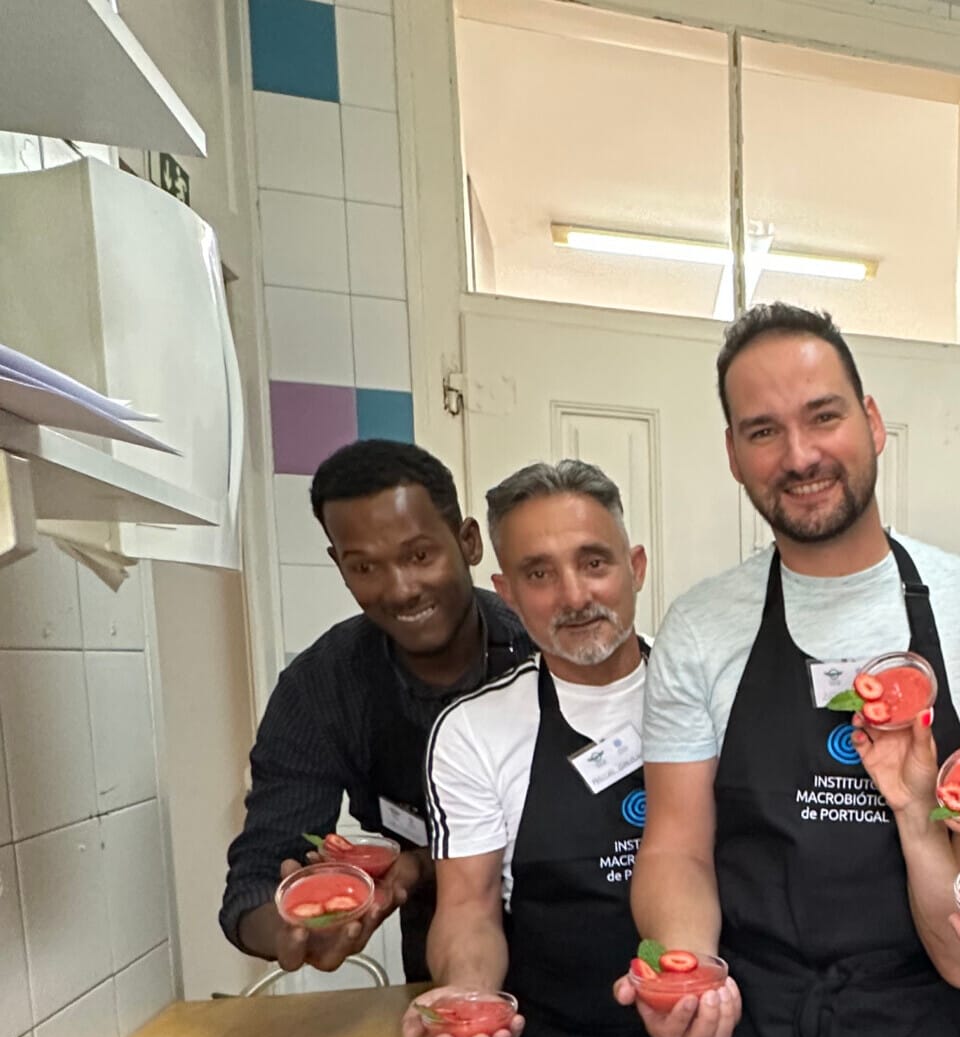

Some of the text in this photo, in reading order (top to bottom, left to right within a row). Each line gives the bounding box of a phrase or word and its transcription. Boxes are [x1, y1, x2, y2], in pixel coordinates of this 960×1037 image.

[796, 789, 888, 807] MACROBIÓTIC
[801, 806, 889, 823] de PORTUGAL
[607, 868, 622, 882] de
